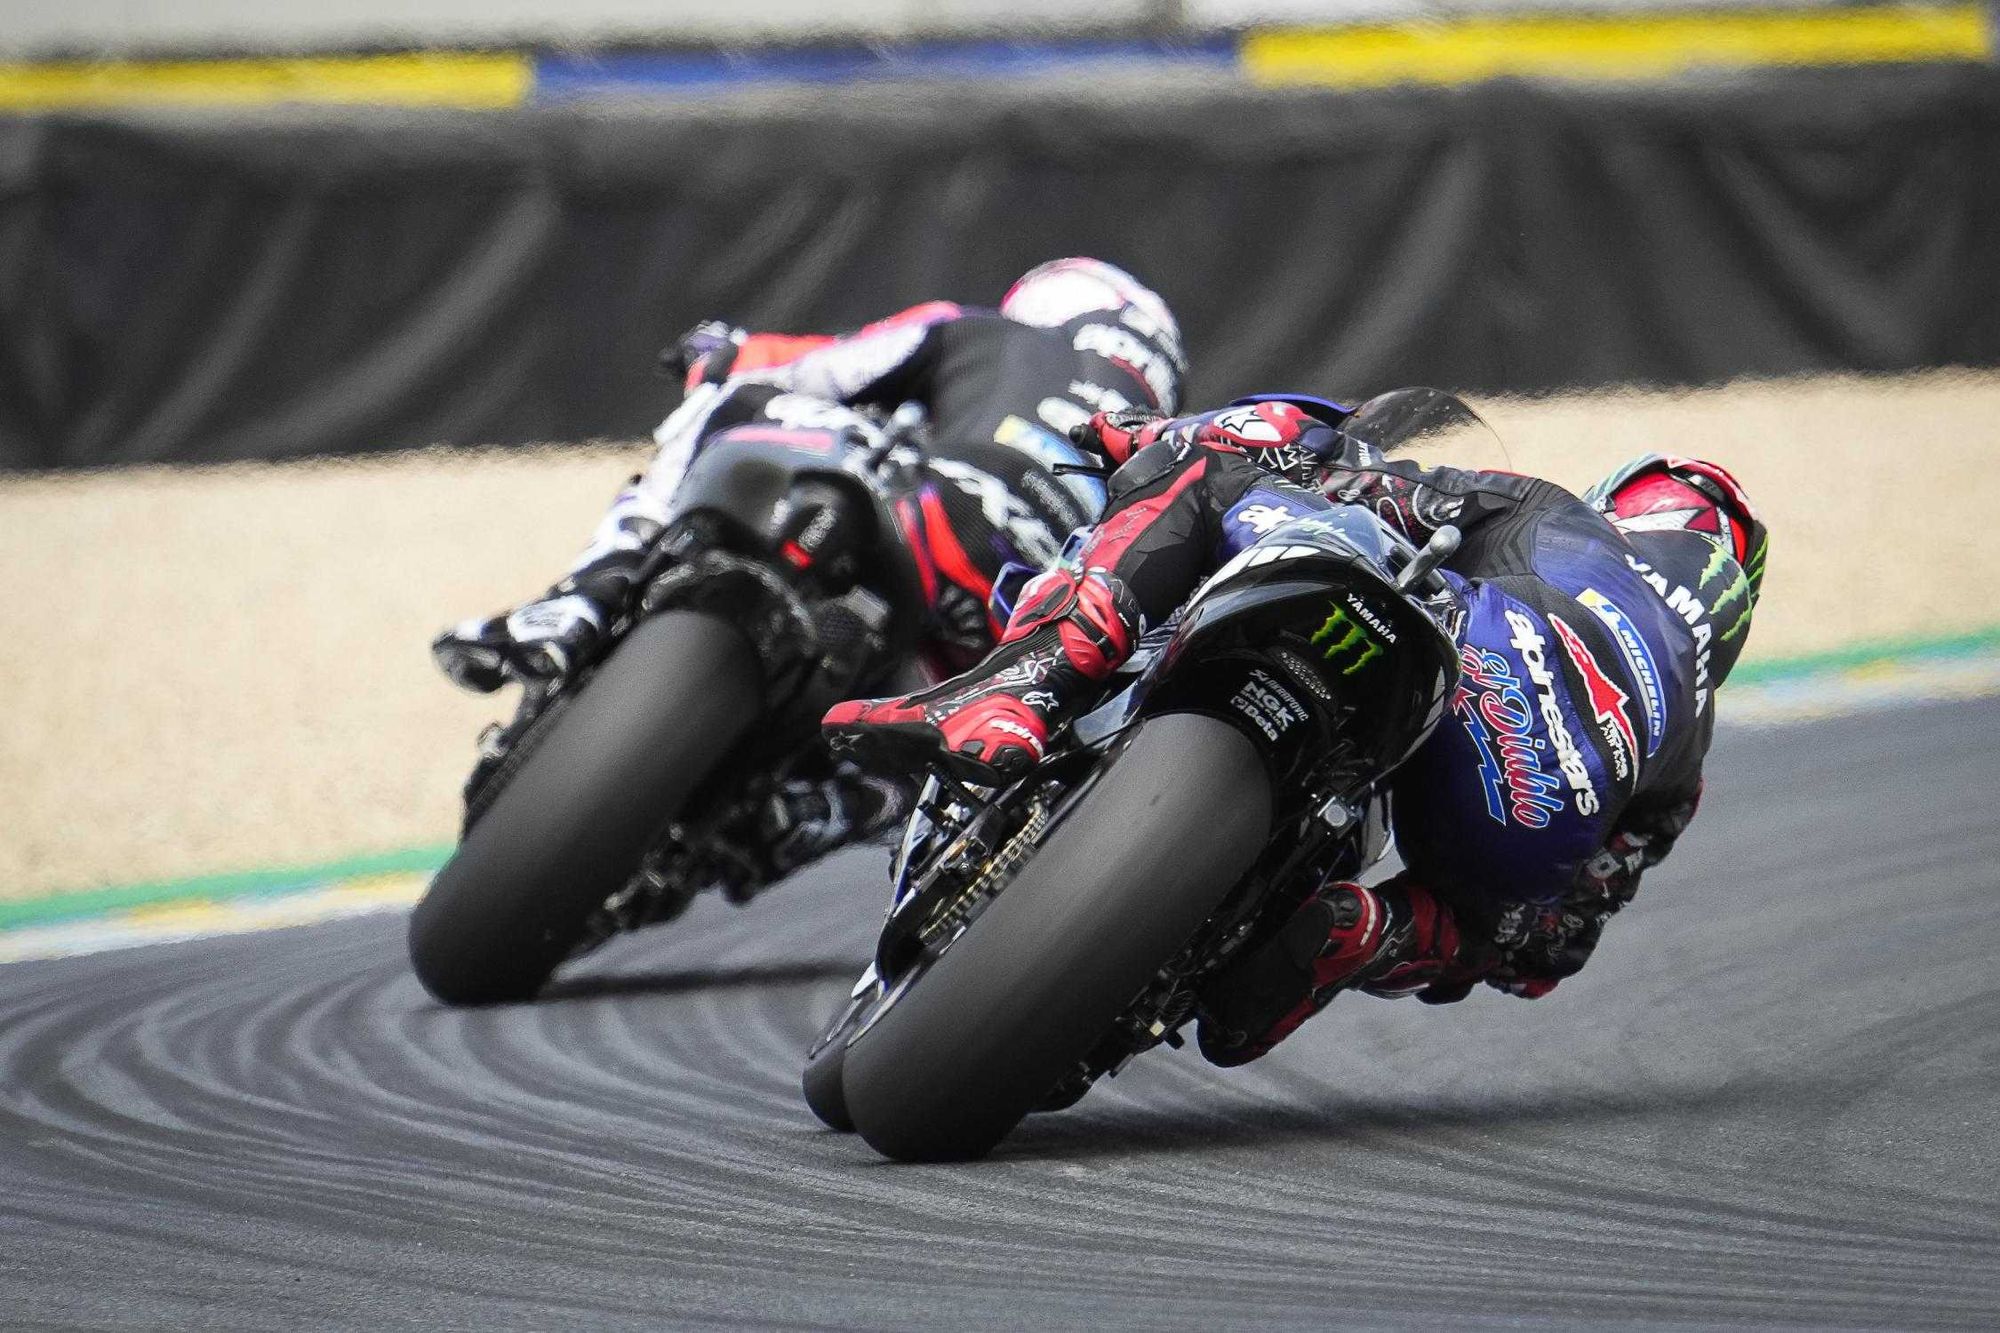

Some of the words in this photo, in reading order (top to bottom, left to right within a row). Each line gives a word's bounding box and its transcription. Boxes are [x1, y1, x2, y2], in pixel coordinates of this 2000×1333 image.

[1346, 593, 1398, 645] YAMAHA
[1625, 553, 1712, 718] YAMAHA
[1243, 681, 1295, 727] NGK
[1505, 609, 1600, 816] alpinestars
[1622, 629, 1661, 736] MICHELIN
[1480, 688, 1565, 828] Diablo
